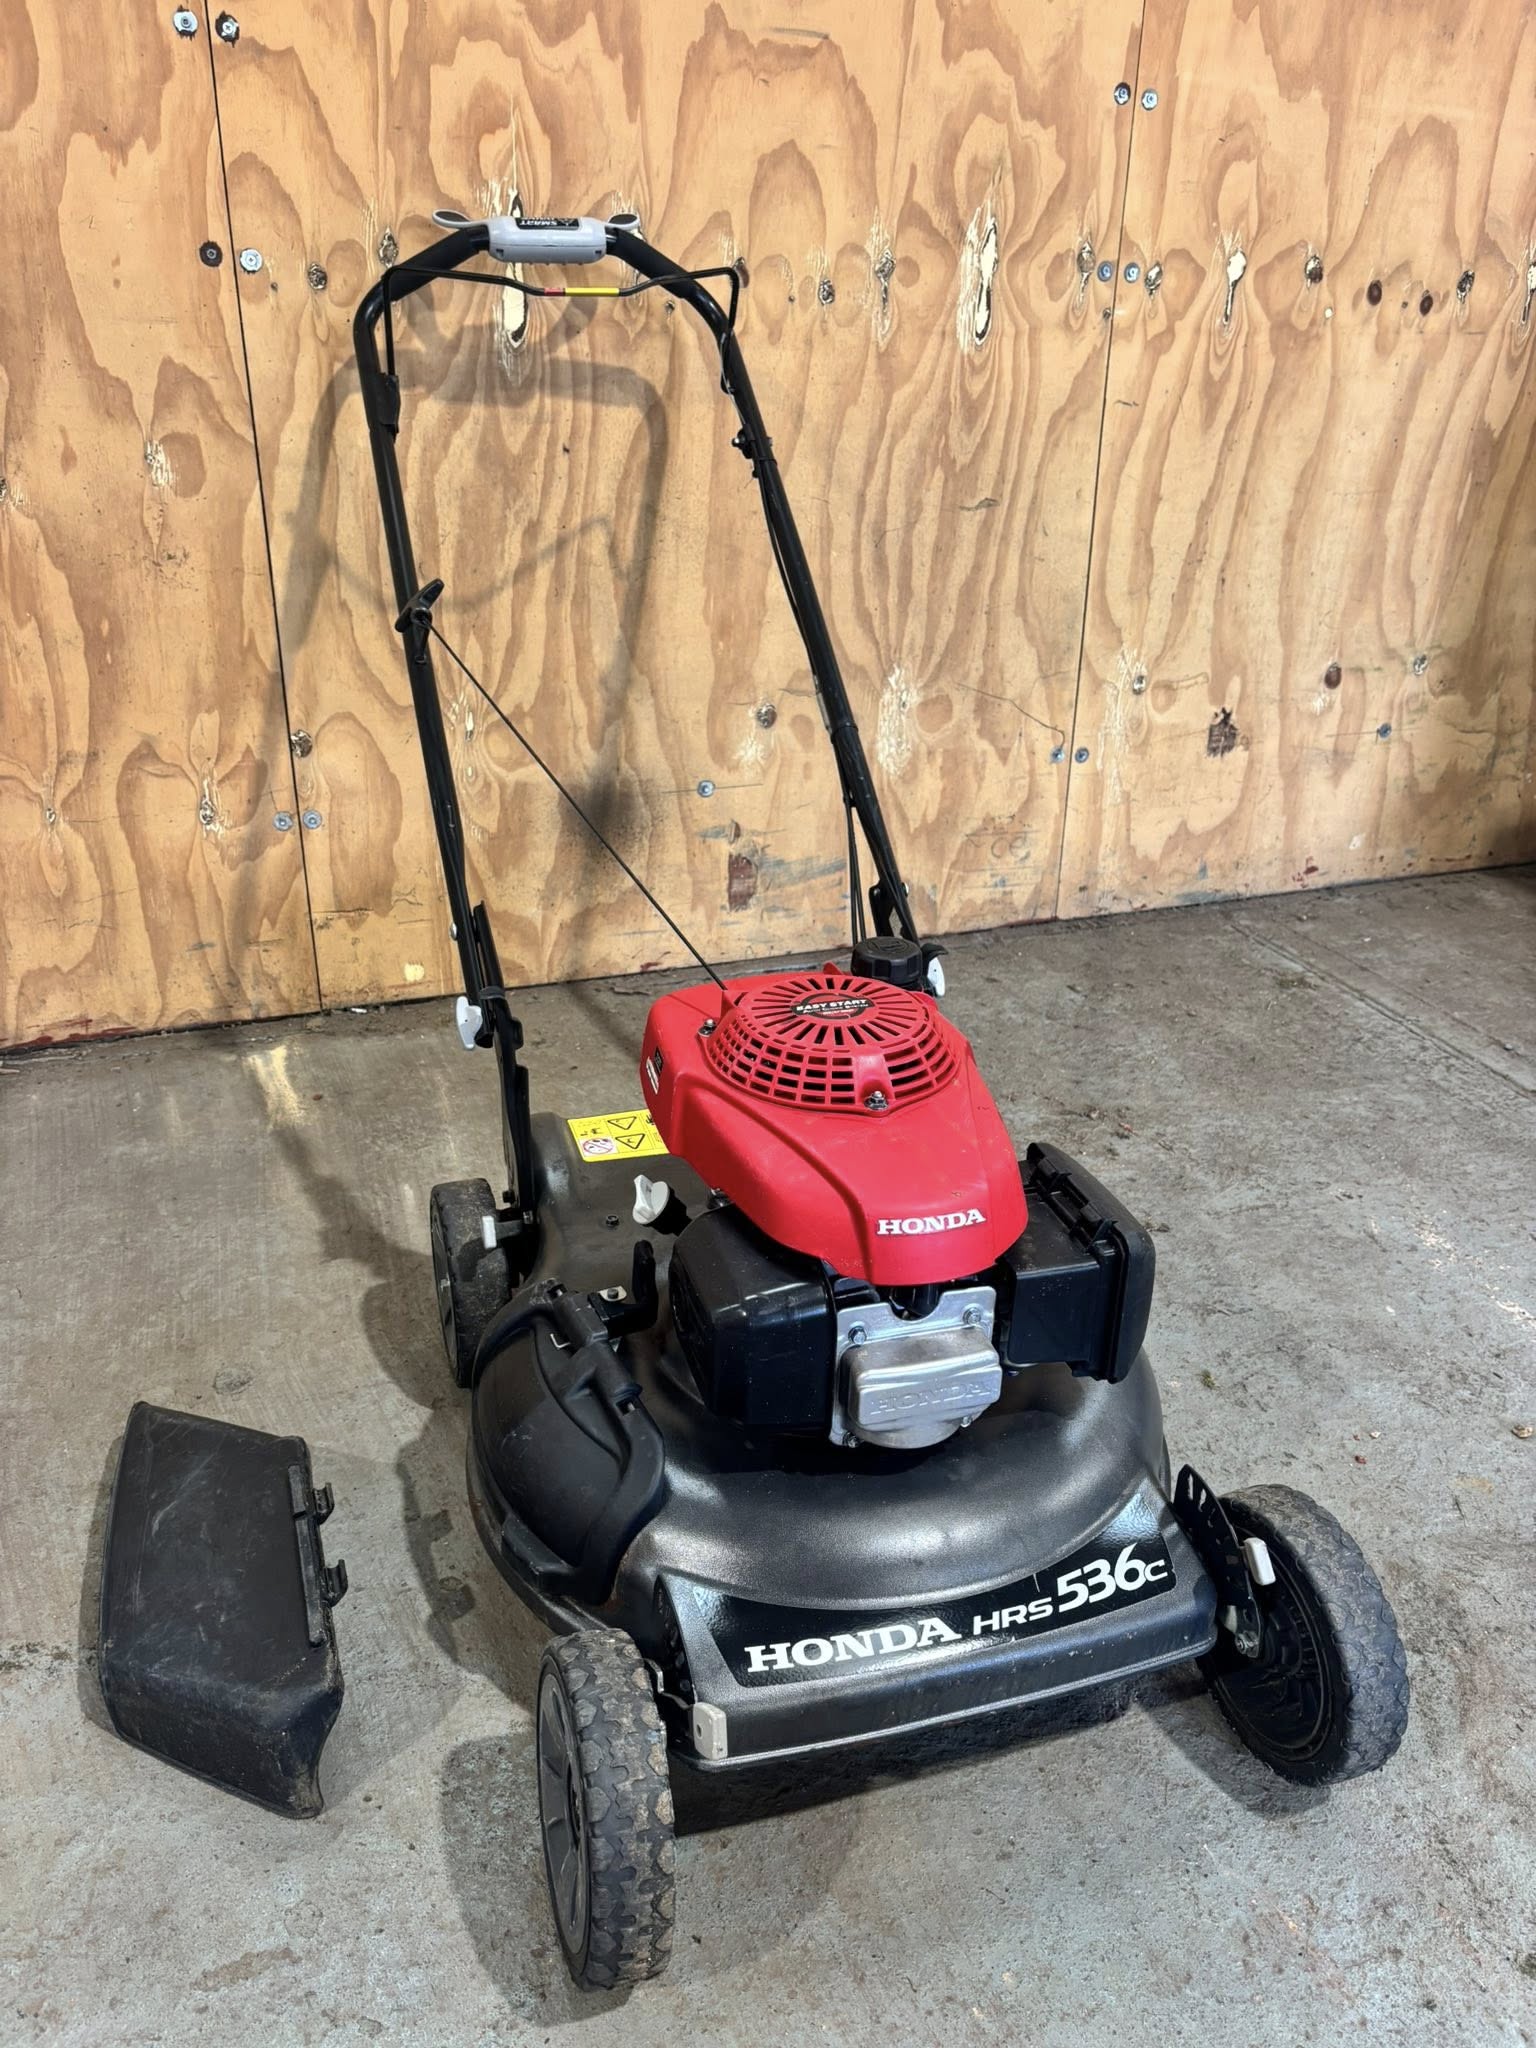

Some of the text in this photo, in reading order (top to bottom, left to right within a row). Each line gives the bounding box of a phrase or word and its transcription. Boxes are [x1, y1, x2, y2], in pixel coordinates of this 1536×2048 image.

[796, 1003, 827, 1011] EASY
[829, 999, 867, 1007] START
[877, 1208, 986, 1235] HONDA
[870, 1383, 991, 1416] HONDA
[744, 1617, 962, 1673] HONDA
